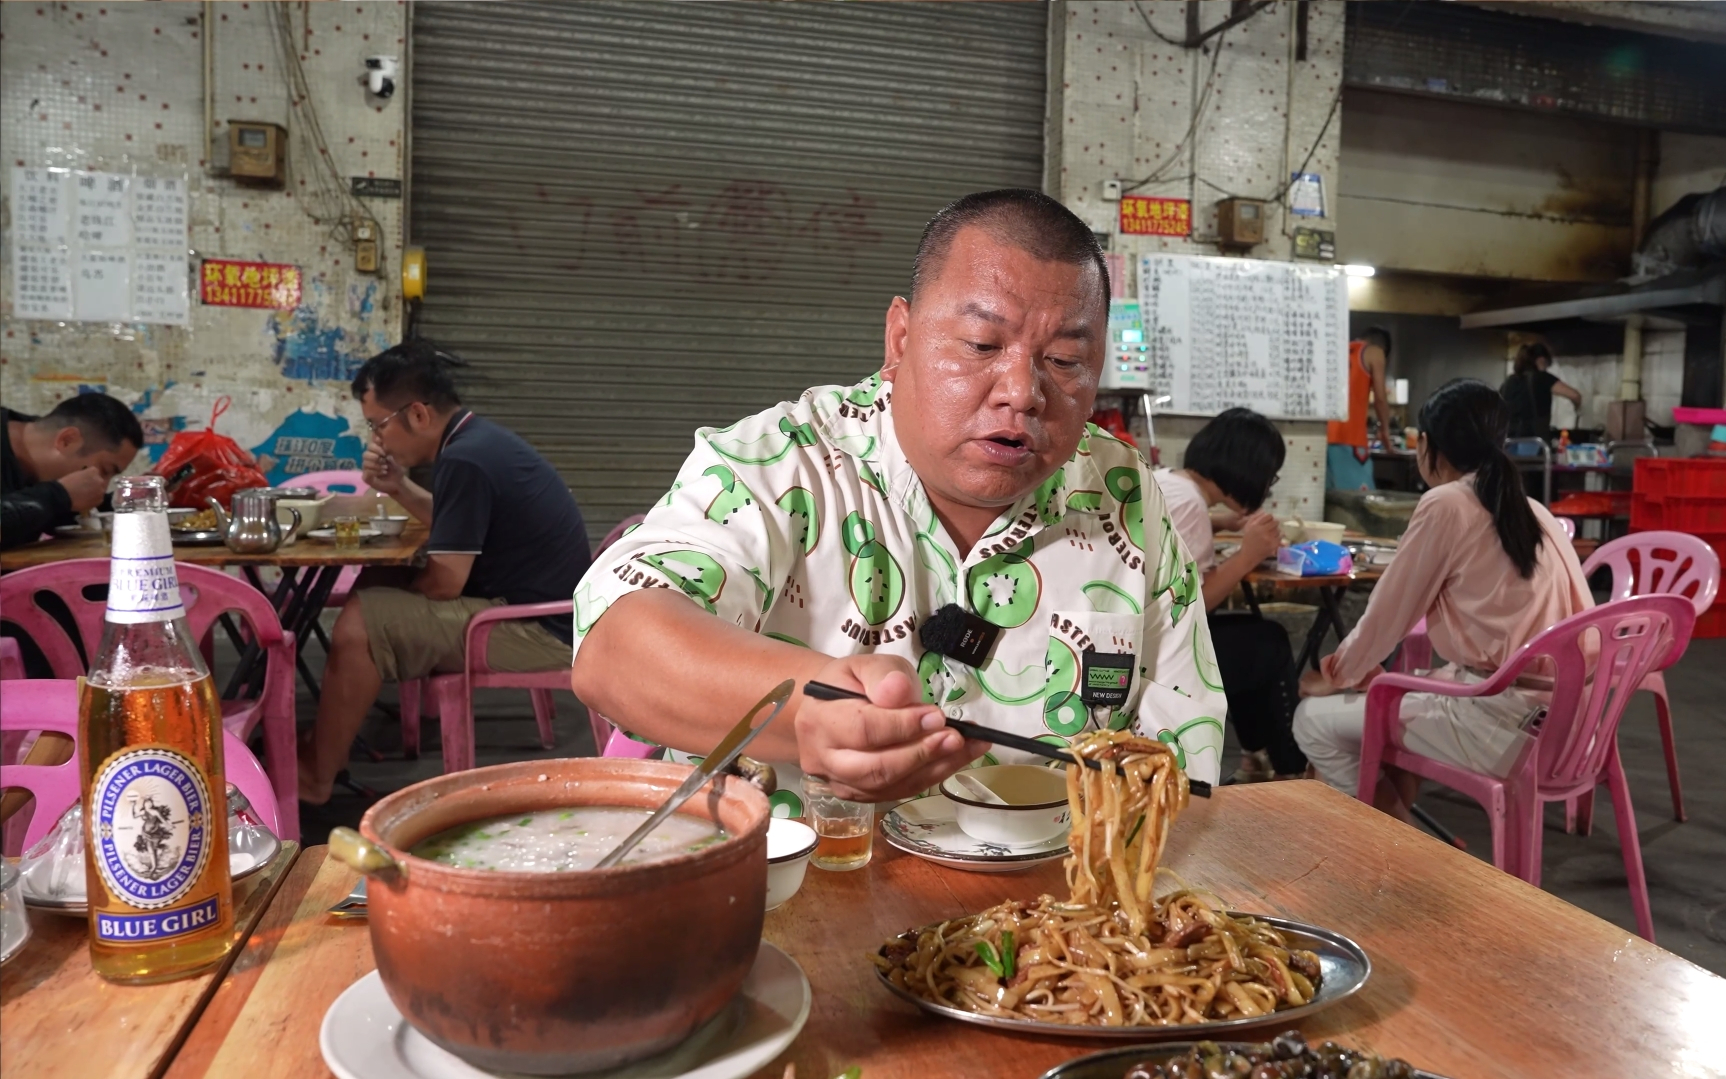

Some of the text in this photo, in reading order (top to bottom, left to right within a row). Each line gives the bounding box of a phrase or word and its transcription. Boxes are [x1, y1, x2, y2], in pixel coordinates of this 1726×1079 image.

[1092, 691, 1123, 700] NEW DESIGN
[102, 762, 200, 818] PILSENER LAGER BIER
[103, 831, 202, 897] PILSENER LAGER BIER
[100, 905, 216, 937] BLUE GIRL
